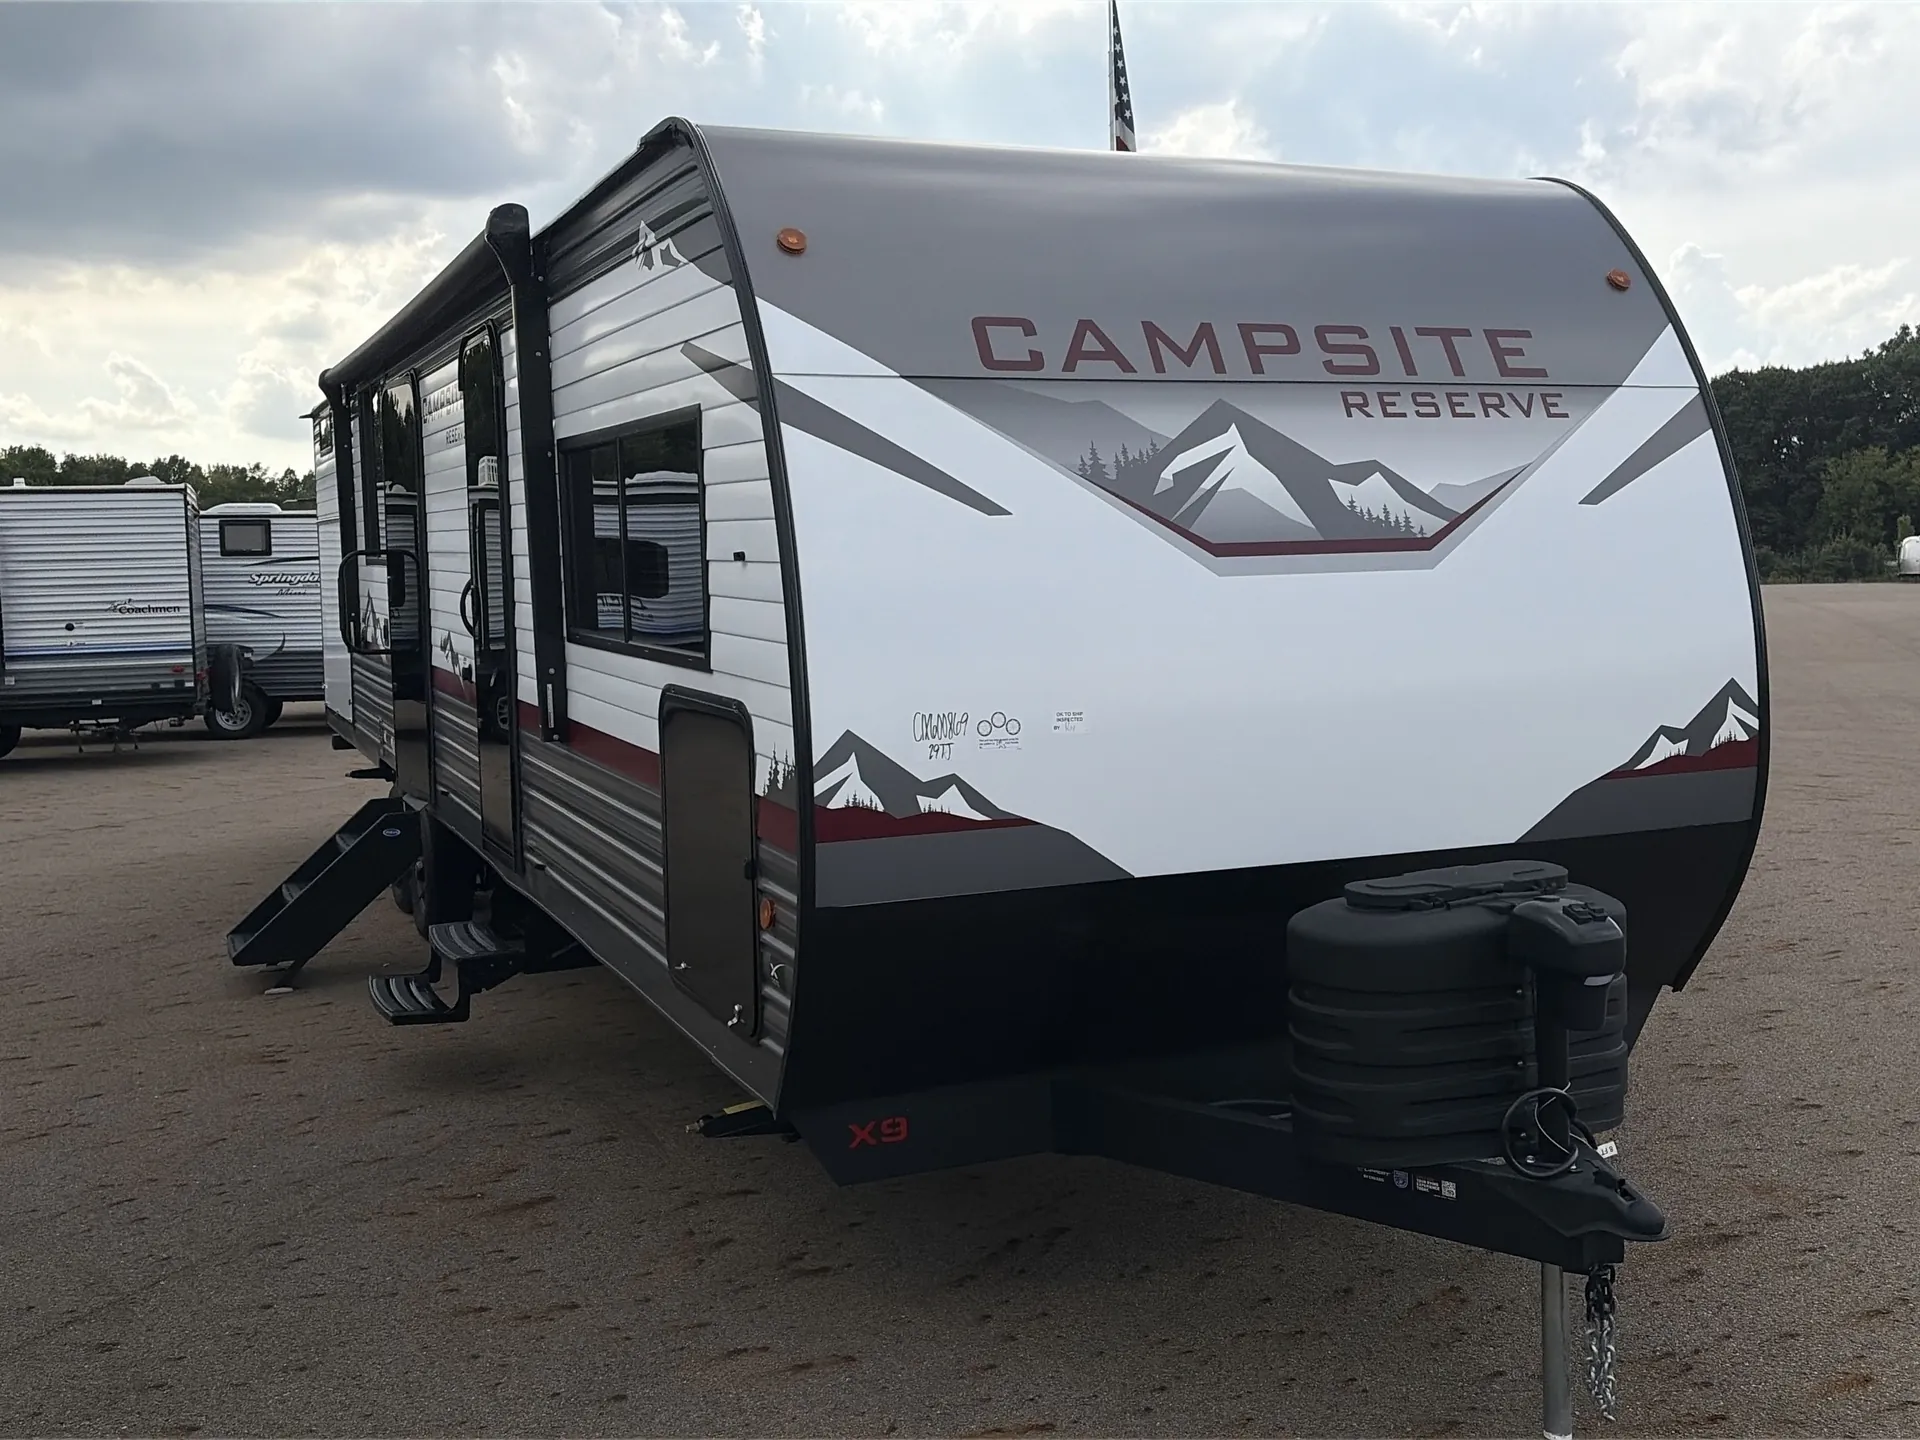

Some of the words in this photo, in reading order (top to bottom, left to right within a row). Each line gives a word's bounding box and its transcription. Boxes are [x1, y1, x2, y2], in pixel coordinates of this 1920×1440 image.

[971, 316, 1549, 378] CAMPSITE
[1340, 391, 1570, 419] RESERVE
[118, 604, 180, 614] Coachmen
[849, 1117, 907, 1148] X9
